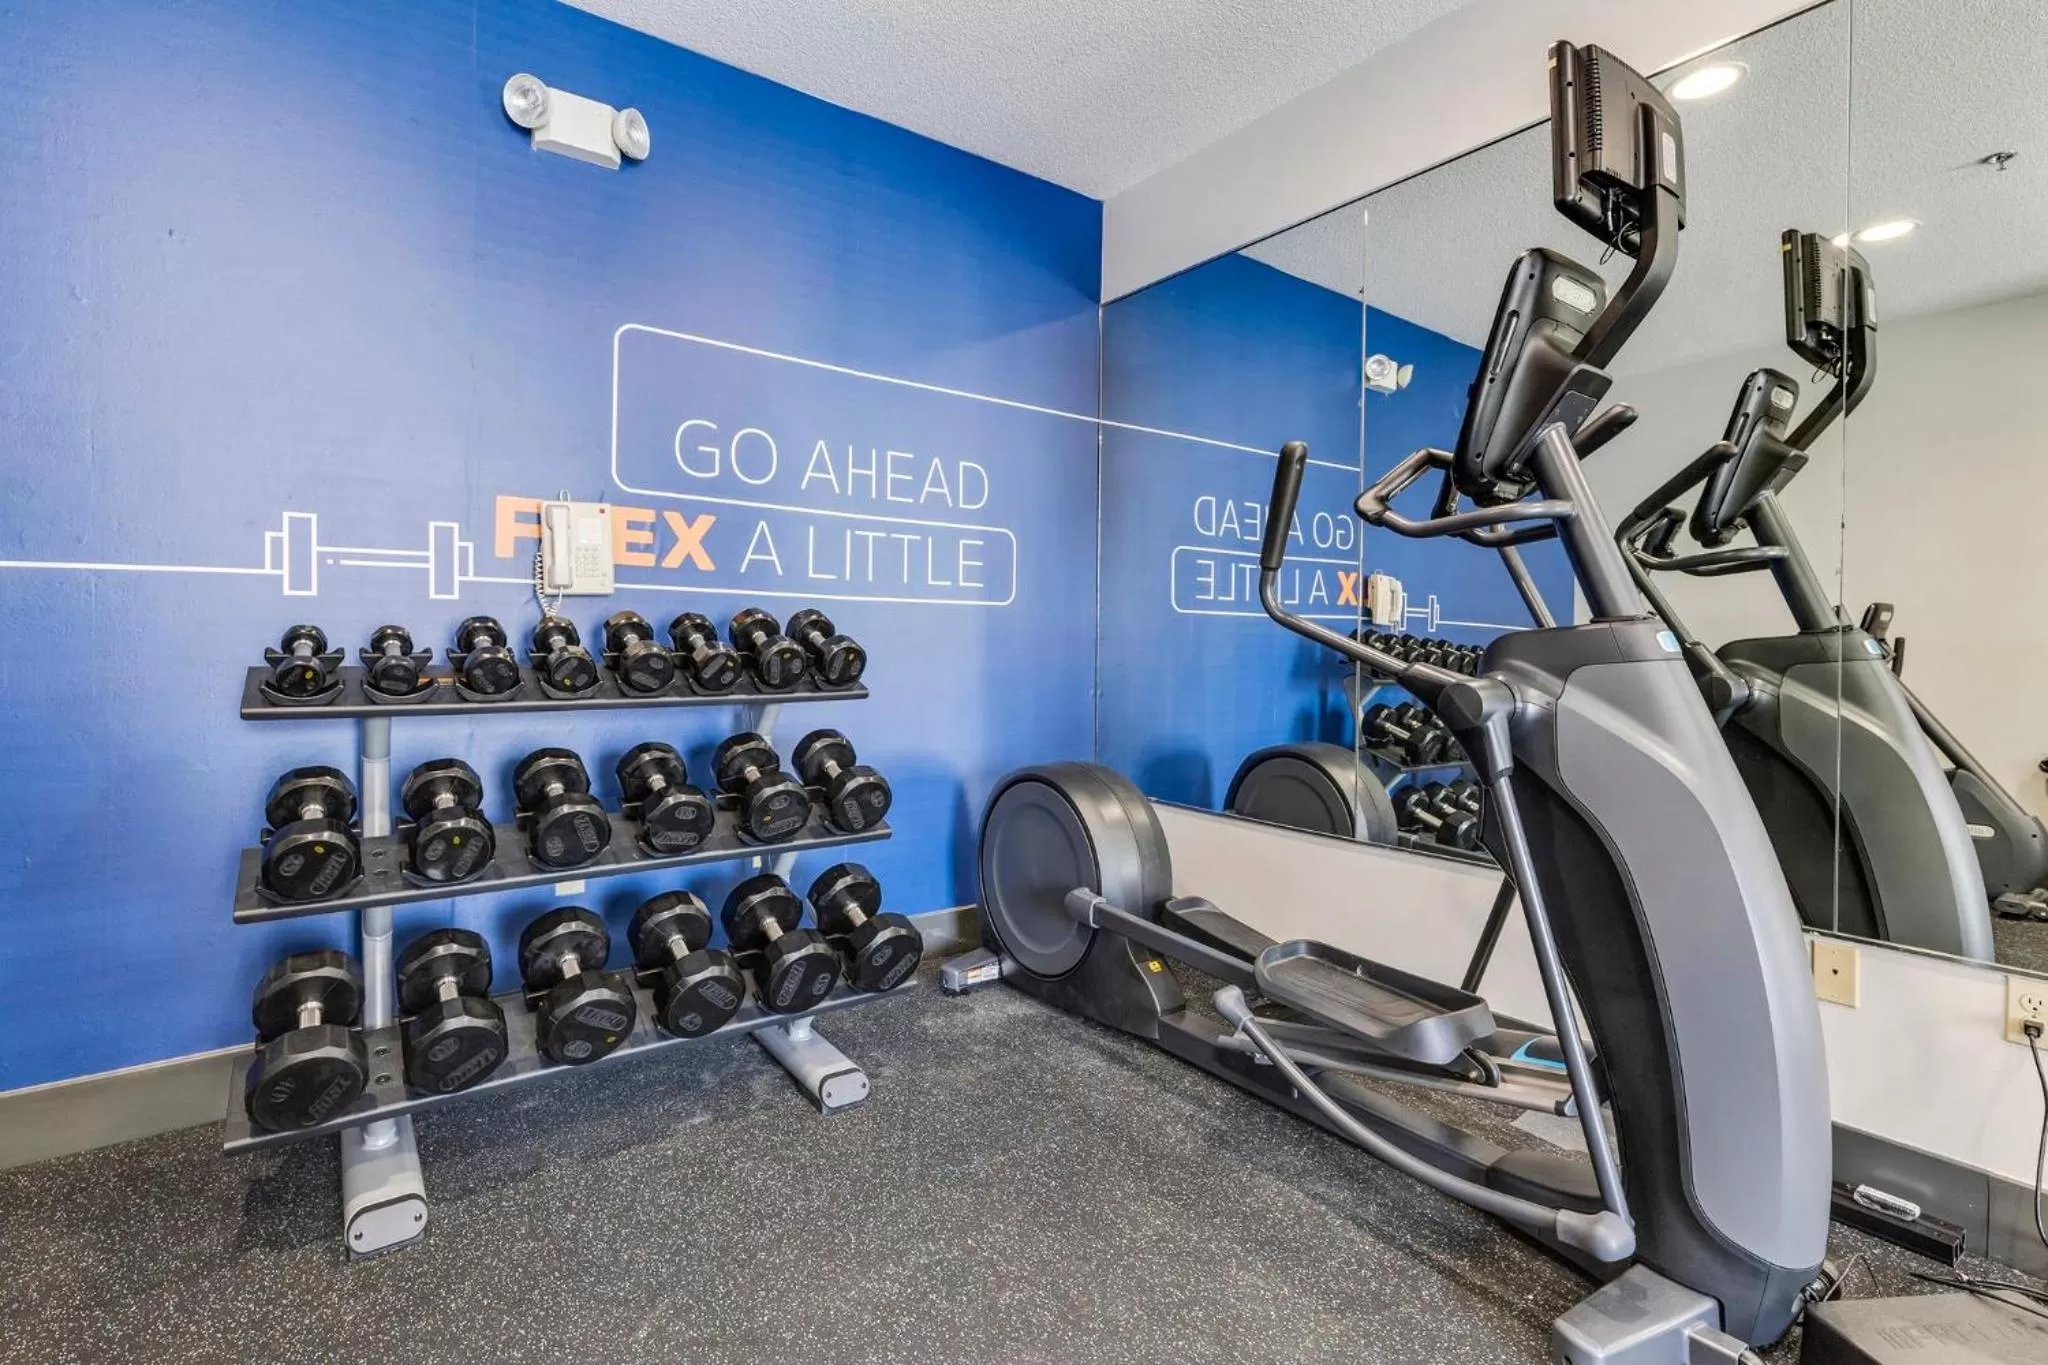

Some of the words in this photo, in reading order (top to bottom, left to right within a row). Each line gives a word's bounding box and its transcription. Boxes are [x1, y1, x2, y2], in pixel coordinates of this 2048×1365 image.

[674, 418, 777, 485] GO
[800, 439, 989, 510] AHEAD
[494, 494, 717, 572] FEX
[740, 520, 783, 577] A
[808, 524, 985, 588] LITTLE
